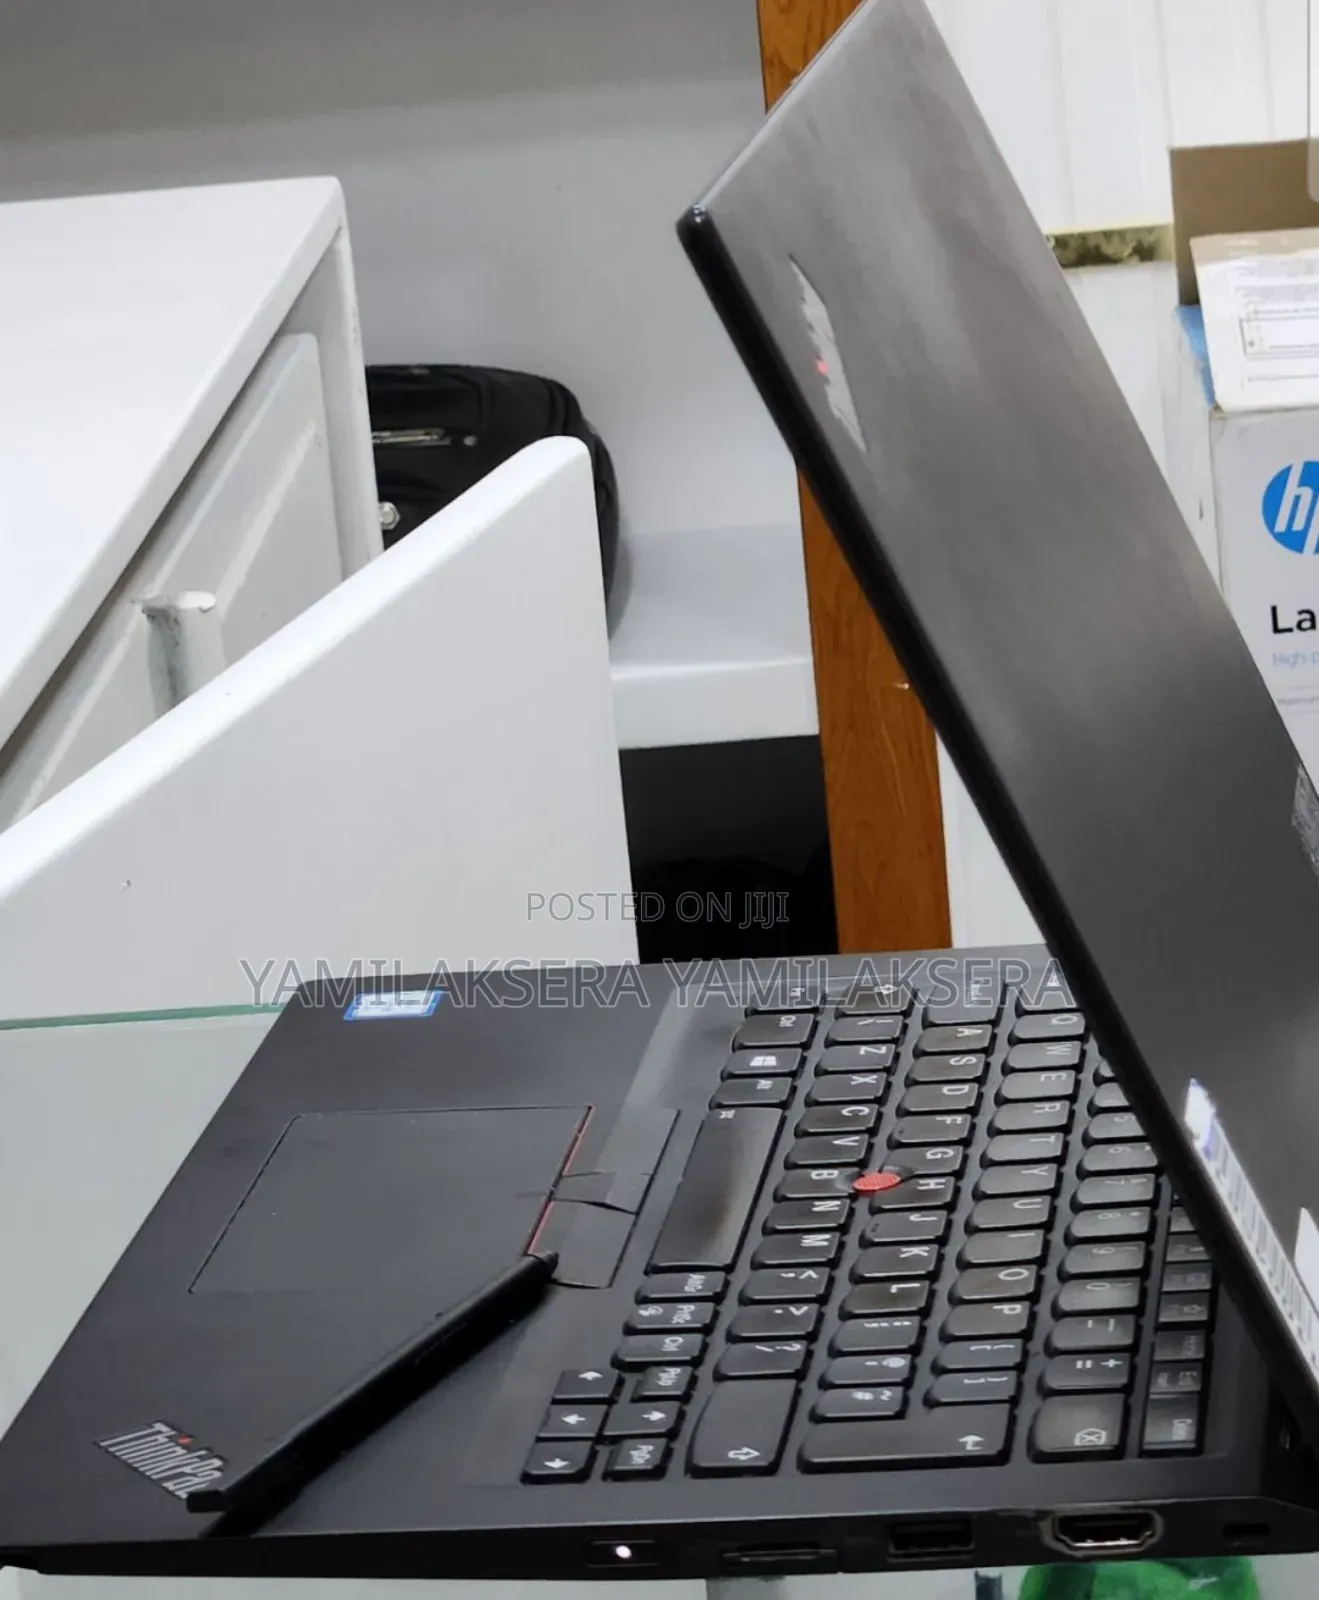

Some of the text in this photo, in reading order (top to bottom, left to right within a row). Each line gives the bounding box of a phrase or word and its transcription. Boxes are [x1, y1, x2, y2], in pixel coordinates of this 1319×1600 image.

[1271, 605, 1317, 634] La
[956, 1028, 982, 1038] A
[860, 1046, 886, 1055] Z
[1046, 1044, 1072, 1055] W
[949, 1056, 977, 1066] S
[851, 1075, 877, 1085] X
[1040, 1073, 1066, 1082] E
[942, 1085, 969, 1095] D
[841, 1106, 869, 1117] C
[1033, 1103, 1060, 1114] R
[936, 1116, 962, 1124] F
[832, 1136, 861, 1146] V
[1029, 1135, 1055, 1144] T
[926, 1147, 954, 1160] G
[810, 1169, 839, 1180] B
[1021, 1165, 1048, 1176] Y
[917, 1179, 946, 1190] H
[811, 1200, 842, 1212] N
[1013, 1199, 1042, 1209] U
[909, 1213, 938, 1222] J
[800, 1234, 831, 1247] M
[899, 1246, 930, 1258] K
[998, 1268, 1029, 1281] O
[890, 1283, 921, 1294] L
[993, 1304, 1022, 1314] P
